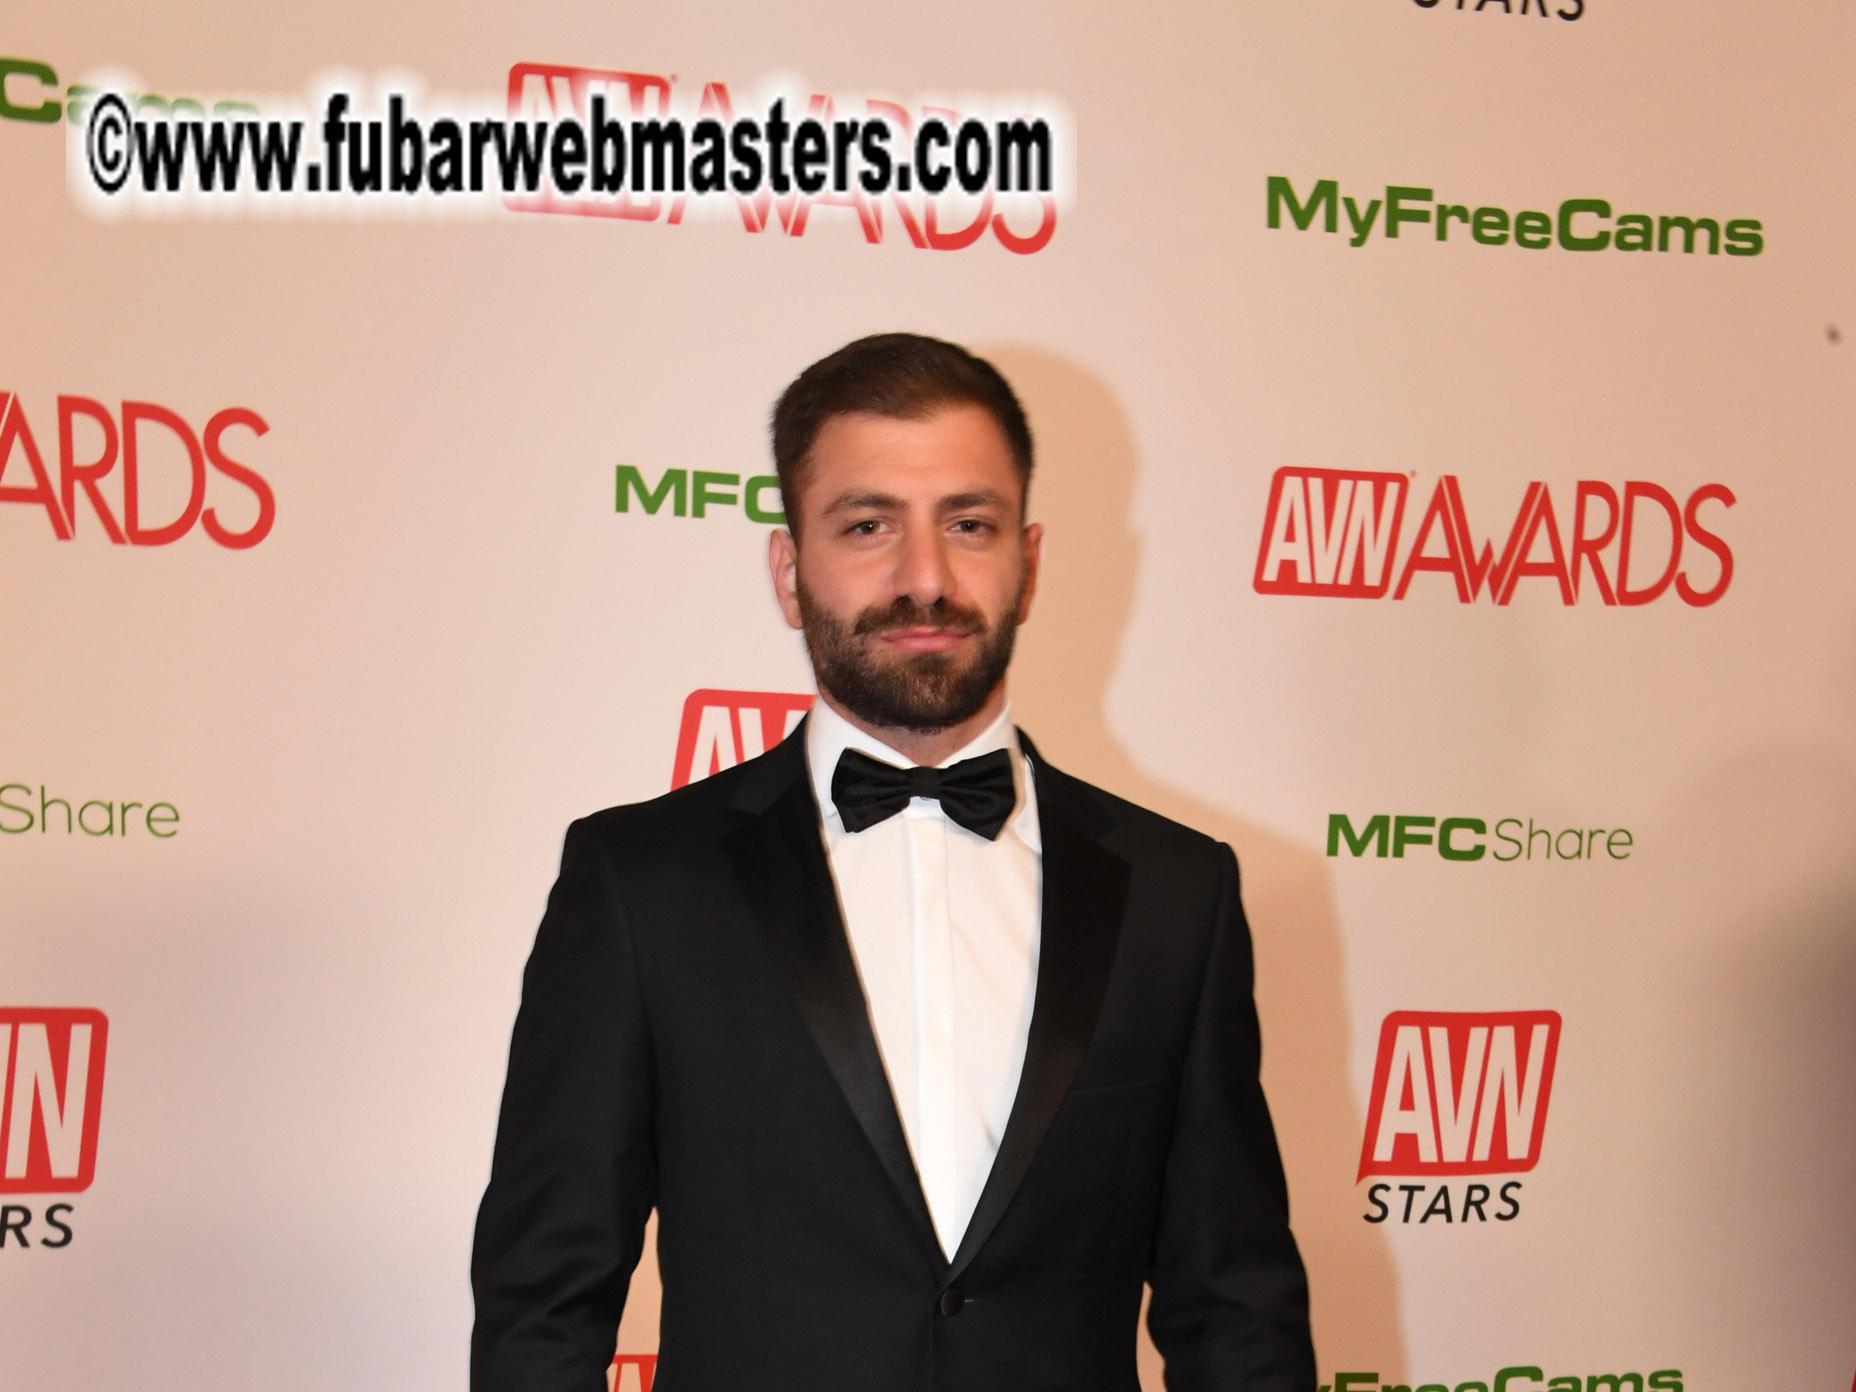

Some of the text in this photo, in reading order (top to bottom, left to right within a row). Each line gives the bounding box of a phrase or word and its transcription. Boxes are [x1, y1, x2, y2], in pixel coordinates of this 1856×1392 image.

[1267, 175, 1763, 256] MyFreeCams
[0, 387, 276, 550] ARDS
[1261, 473, 1738, 608] AVN AWARDS
[1372, 1023, 1551, 1164] AVN
[1362, 1181, 1522, 1225] STARS
